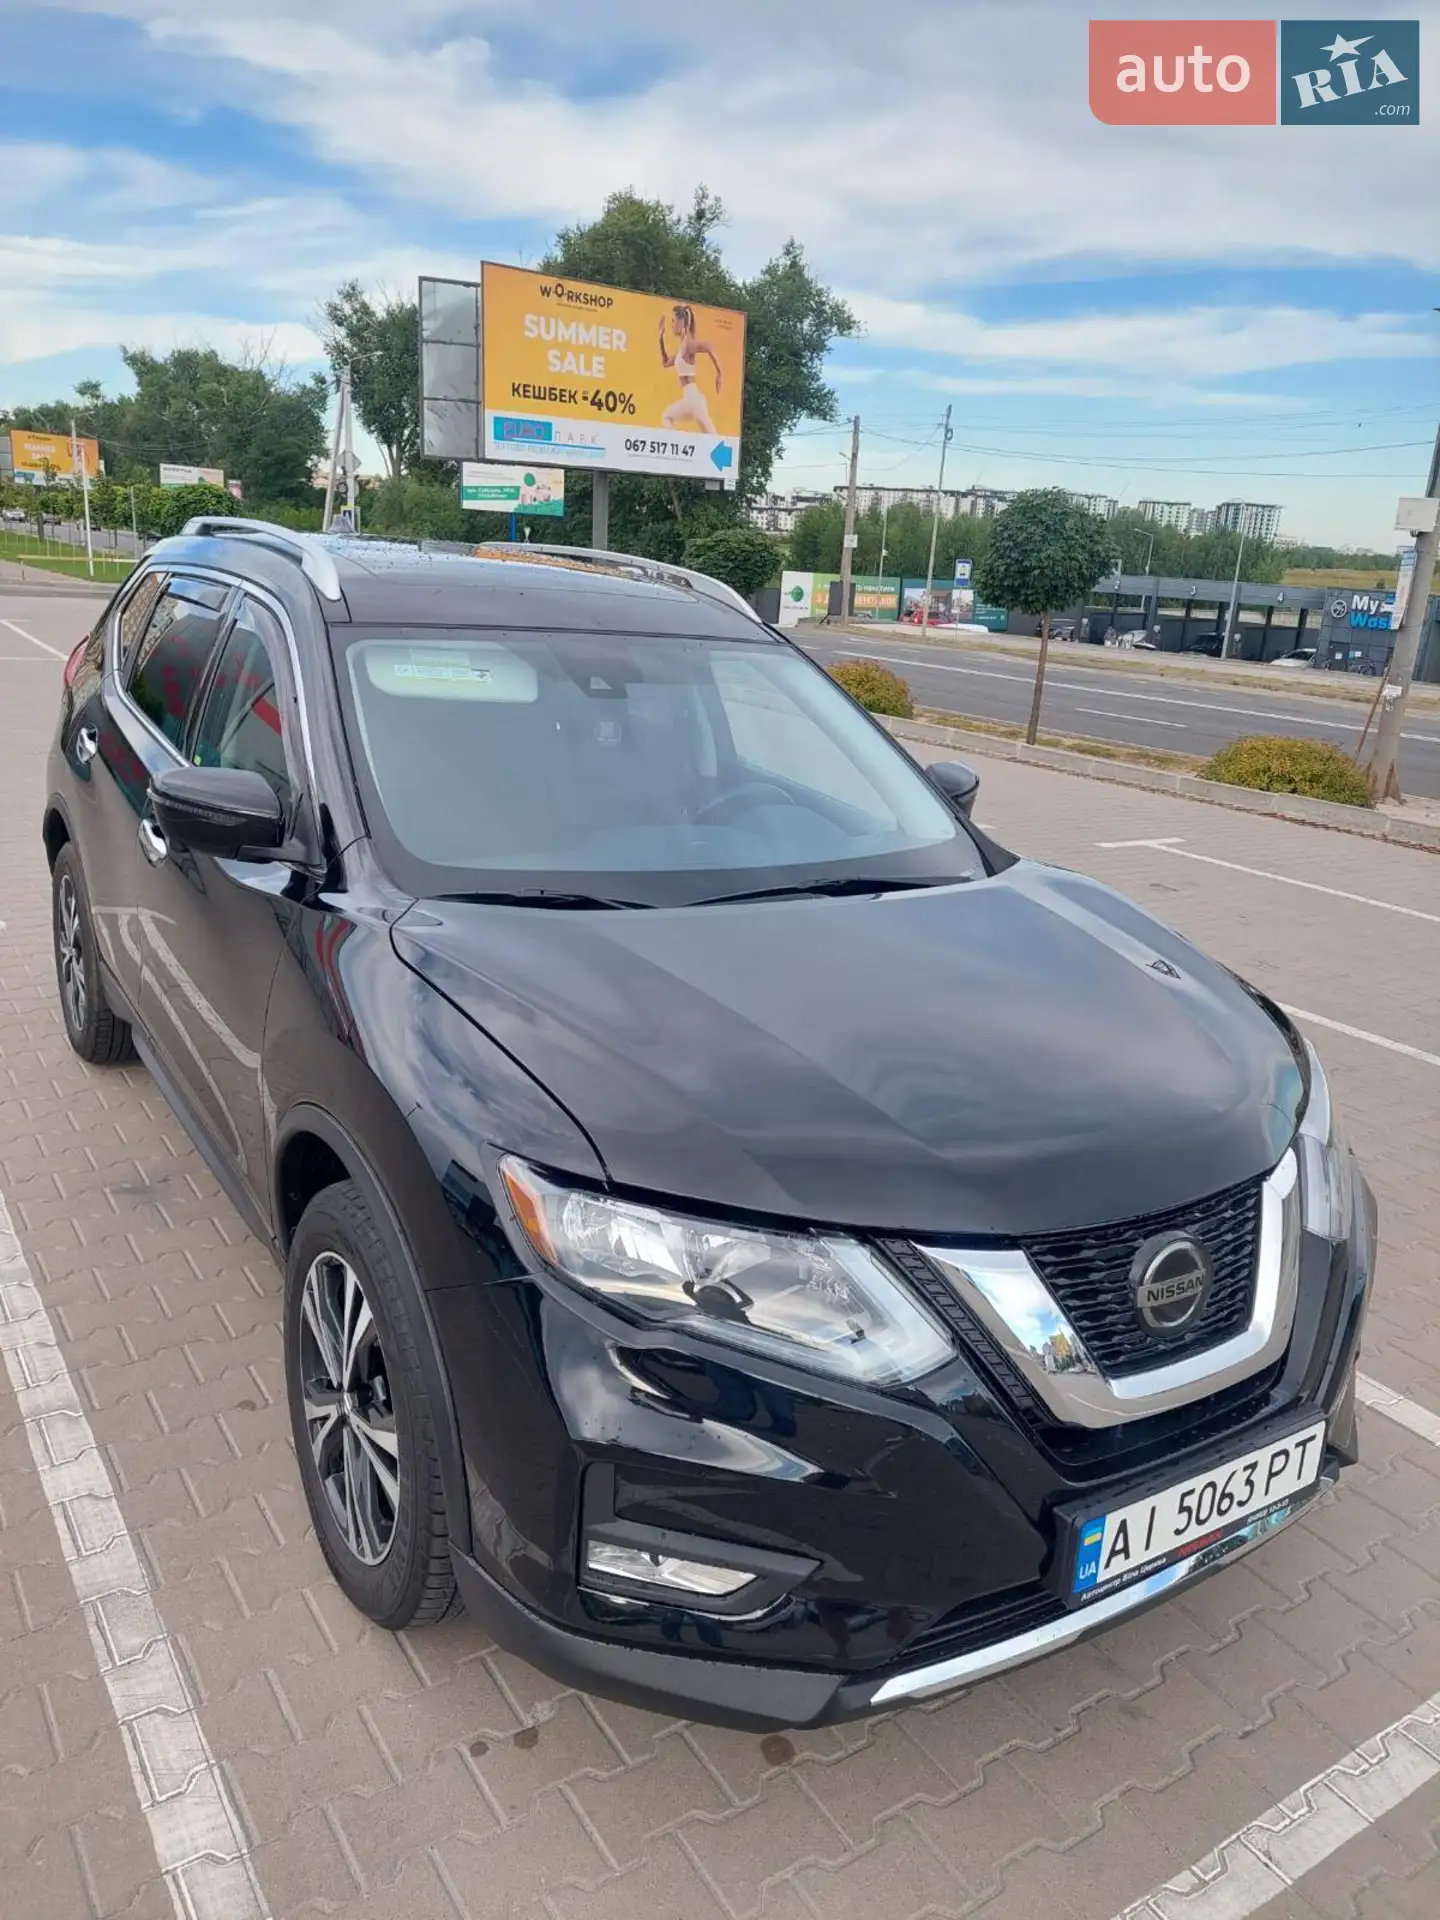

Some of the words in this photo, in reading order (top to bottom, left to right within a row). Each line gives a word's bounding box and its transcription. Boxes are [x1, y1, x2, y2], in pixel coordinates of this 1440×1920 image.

[540, 283, 614, 308] WORKSHOP
[524, 313, 627, 352] SUMMER
[547, 349, 606, 378] SALE
[511, 382, 578, 405] КЕШБЕК
[625, 438, 646, 452] 067
[650, 441, 668, 454] 517
[671, 443, 679, 455] 11
[682, 445, 695, 457] 47
[1190, 585, 1196, 595] 3
[1277, 592, 1284, 603] 4
[1351, 594, 1379, 615] My
[1147, 1273, 1205, 1301] NISSAN
[1104, 1505, 1156, 1570] AI
[1173, 1460, 1258, 1536] 5063
[1264, 1434, 1317, 1497] PT
[1079, 1560, 1096, 1580] UA
